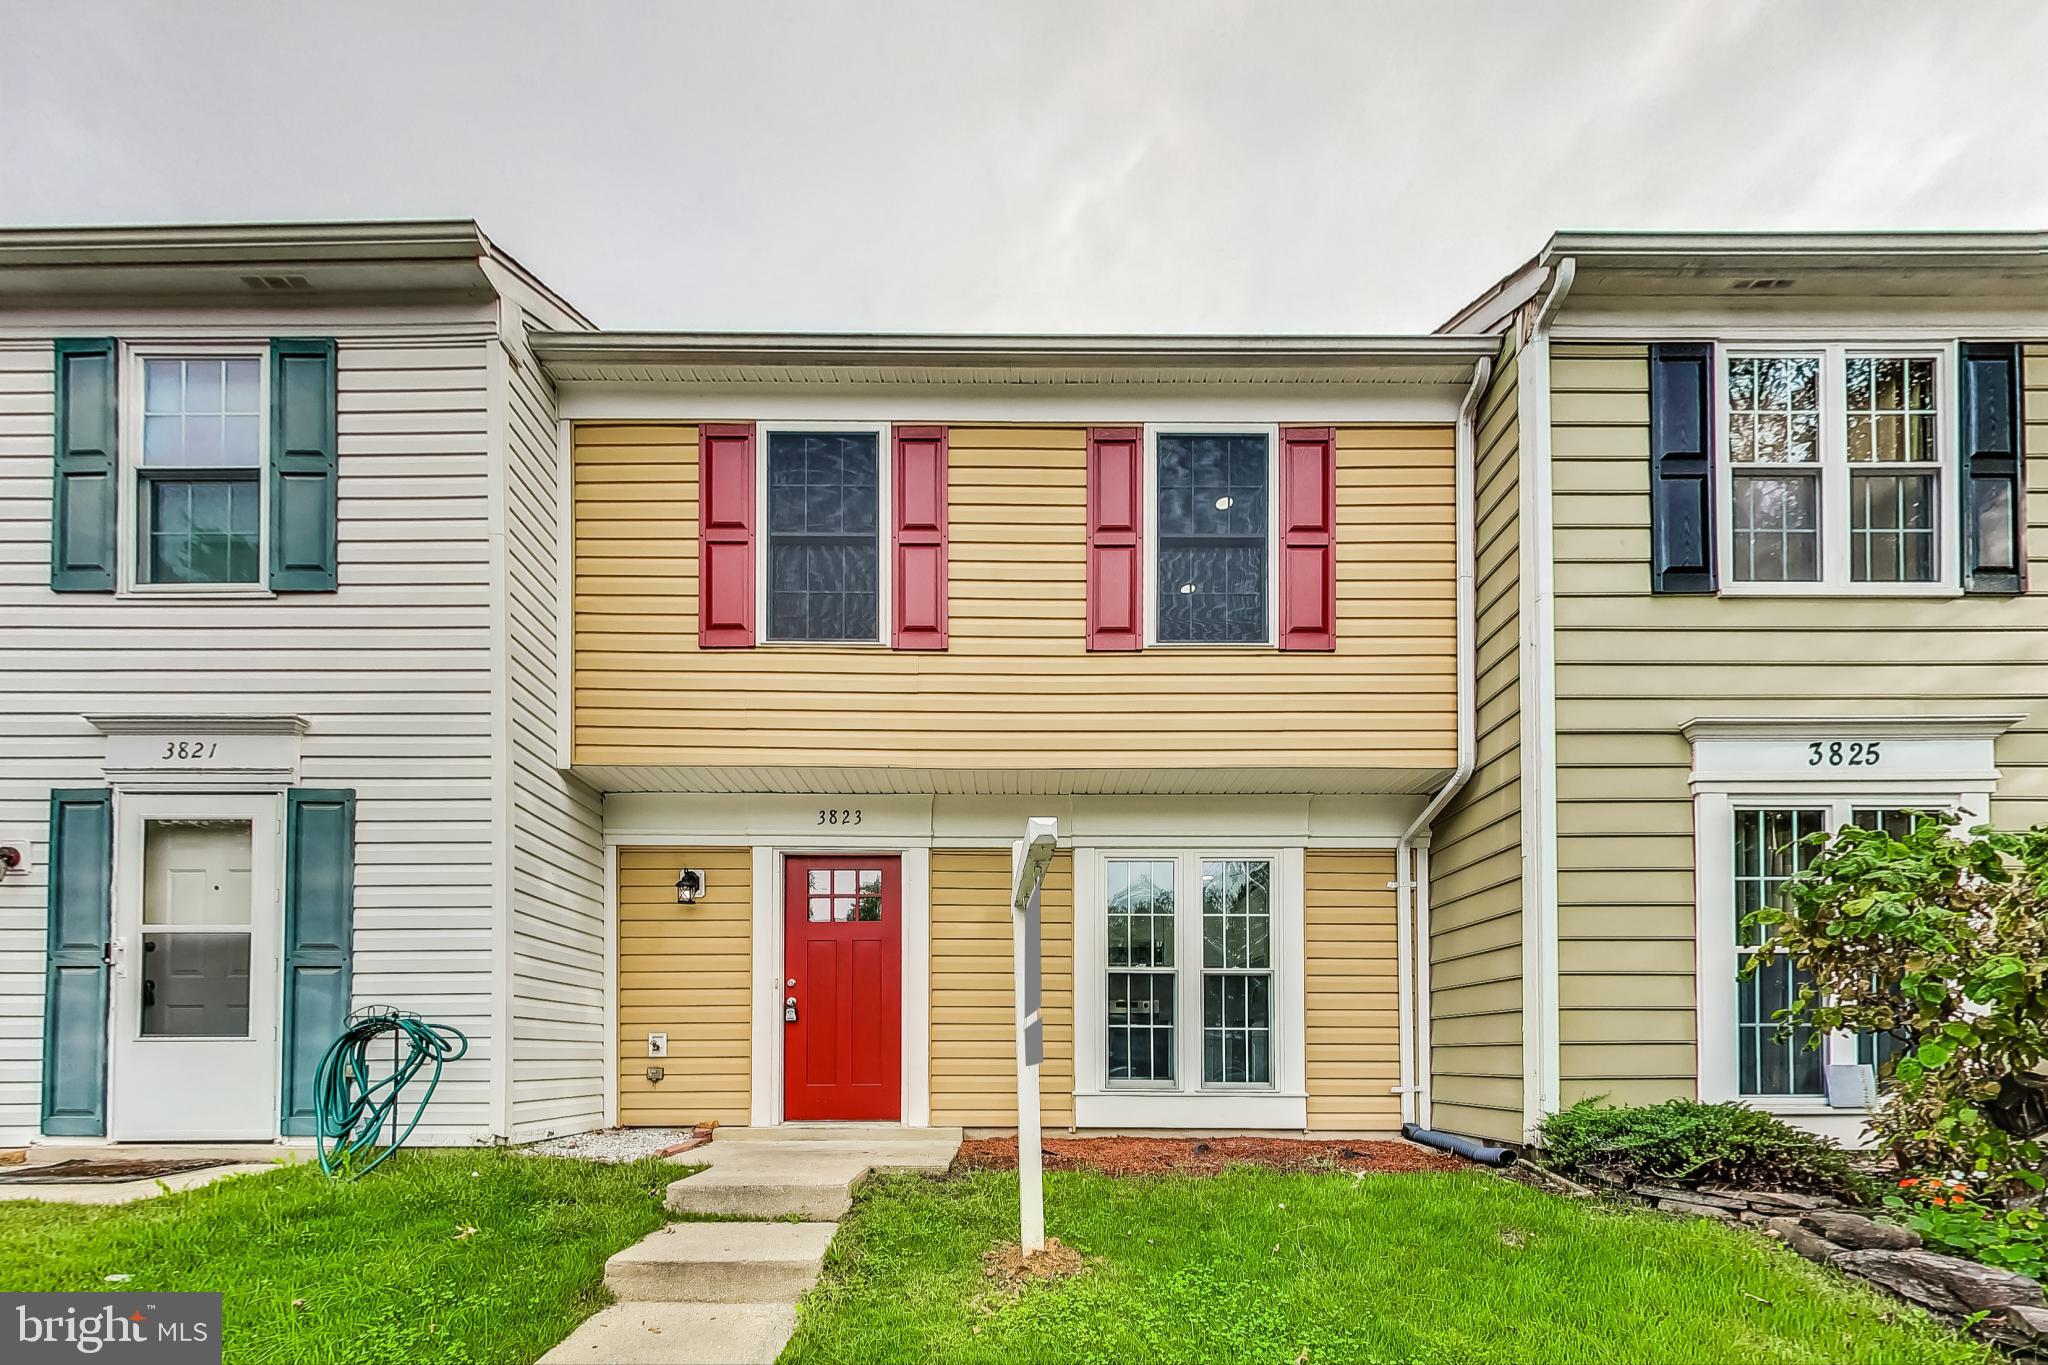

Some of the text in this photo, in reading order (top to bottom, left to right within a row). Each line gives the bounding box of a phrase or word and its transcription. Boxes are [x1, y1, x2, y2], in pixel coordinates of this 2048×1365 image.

[161, 741, 217, 760] 3821
[1808, 741, 1881, 766] 3825
[817, 809, 862, 826] 3823
